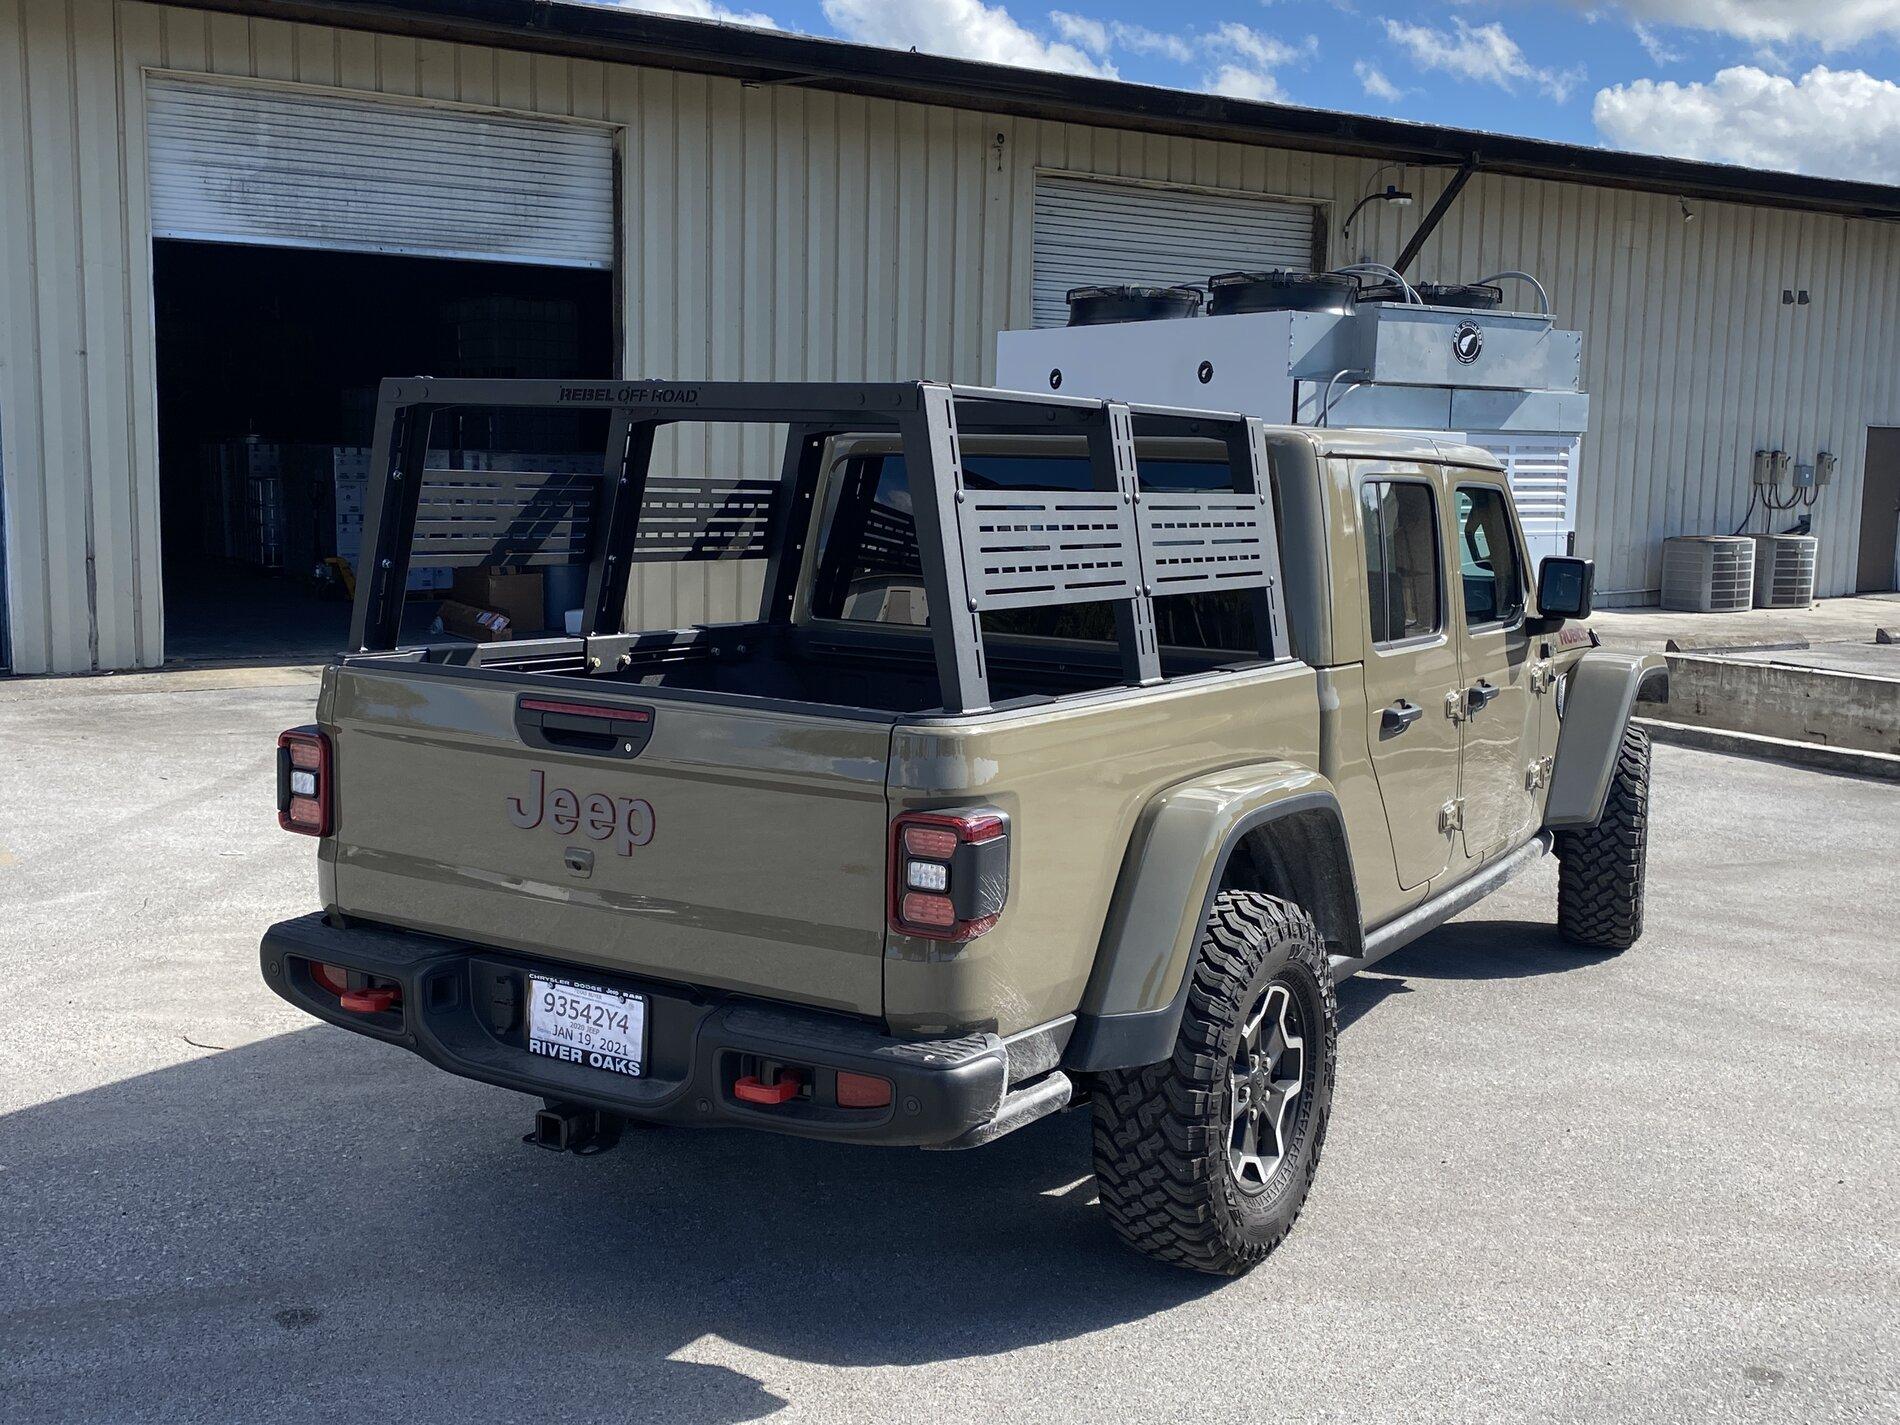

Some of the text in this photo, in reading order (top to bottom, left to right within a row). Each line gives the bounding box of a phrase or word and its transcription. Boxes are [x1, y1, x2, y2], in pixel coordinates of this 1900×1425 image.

[560, 387, 698, 403] REBEL OFF ROAD
[506, 769, 656, 857] Jeep
[528, 973, 570, 986] CHRYSLER
[573, 982, 602, 992] DODGE
[623, 992, 642, 1001] RAM
[544, 992, 629, 1034] 93542Y4
[552, 1025, 573, 1041] JAN
[578, 1032, 595, 1049] 19,
[600, 1038, 628, 1056] 2021
[586, 1025, 600, 1035] JEEP
[529, 1039, 641, 1076] RIVER OAKS
